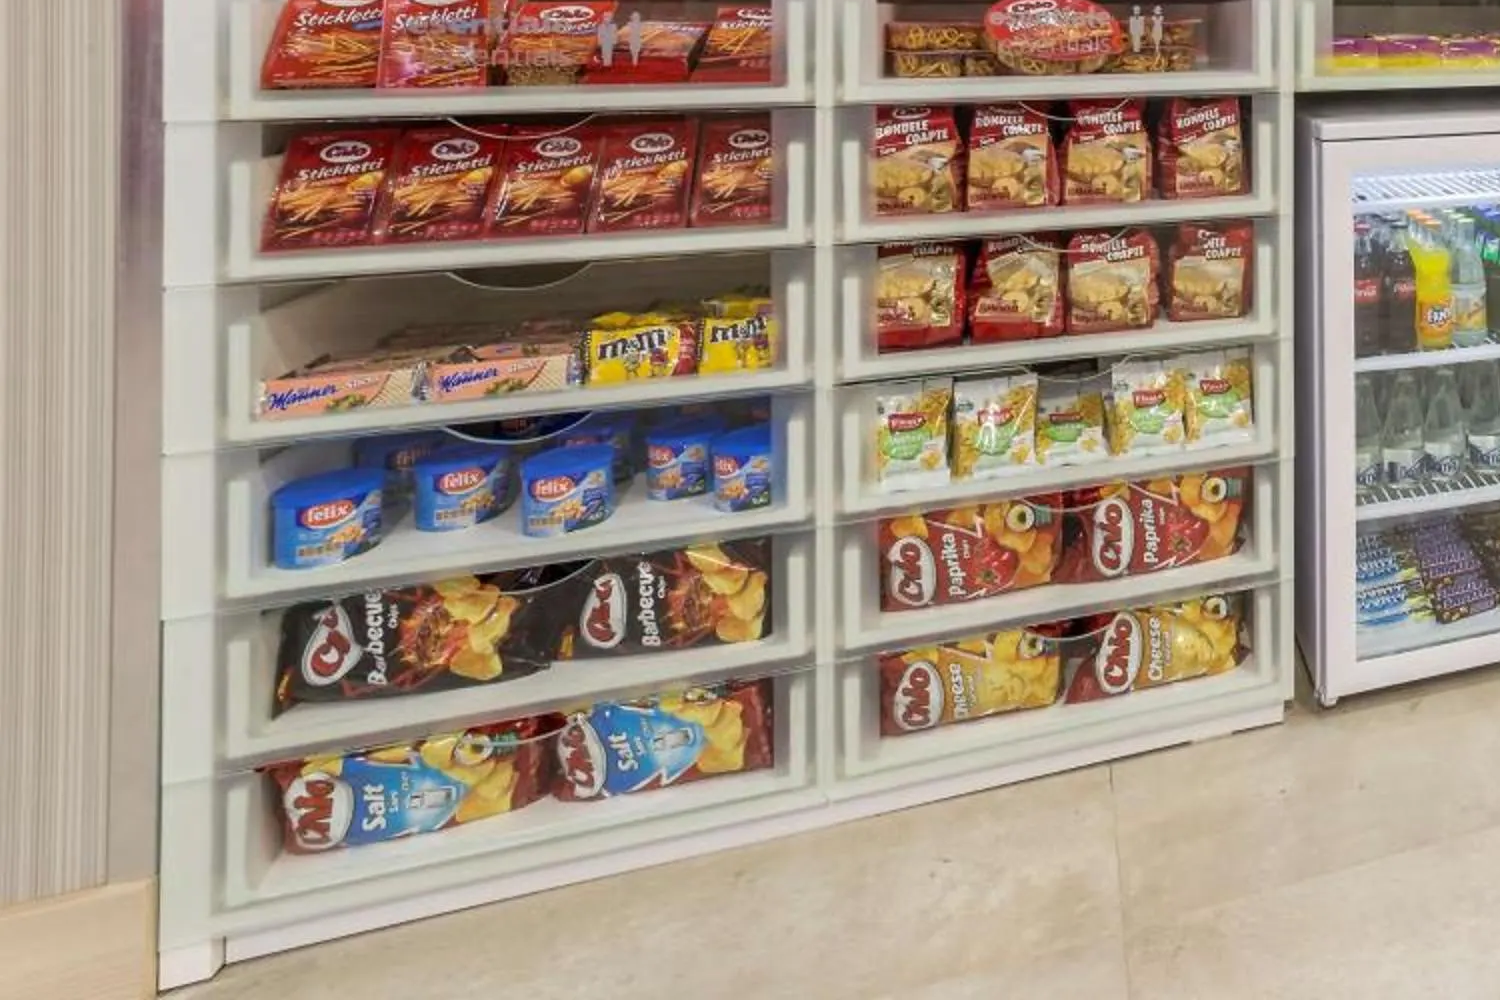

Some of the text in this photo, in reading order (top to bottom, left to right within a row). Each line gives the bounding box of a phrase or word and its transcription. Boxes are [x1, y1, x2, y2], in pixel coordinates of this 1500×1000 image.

[298, 158, 384, 181] Stickletti
[410, 154, 493, 178] Stickletti
[515, 152, 592, 173] Stickletti
[612, 148, 688, 170] Stickletti
[441, 469, 487, 491] felix
[534, 477, 574, 497] felix
[302, 501, 351, 525] felix
[1099, 503, 1123, 570] Chio
[1139, 499, 1161, 563] Paprika
[898, 542, 923, 603] Chio
[941, 533, 968, 597] Paprika
[638, 560, 661, 647] Barbecue
[365, 588, 388, 686] Barbecue
[1103, 618, 1133, 686] Chio
[1147, 616, 1163, 681] Cheese
[901, 667, 931, 726] Chio
[607, 731, 639, 772] Salt
[295, 779, 335, 845] Chio
[361, 783, 387, 832] Salt
